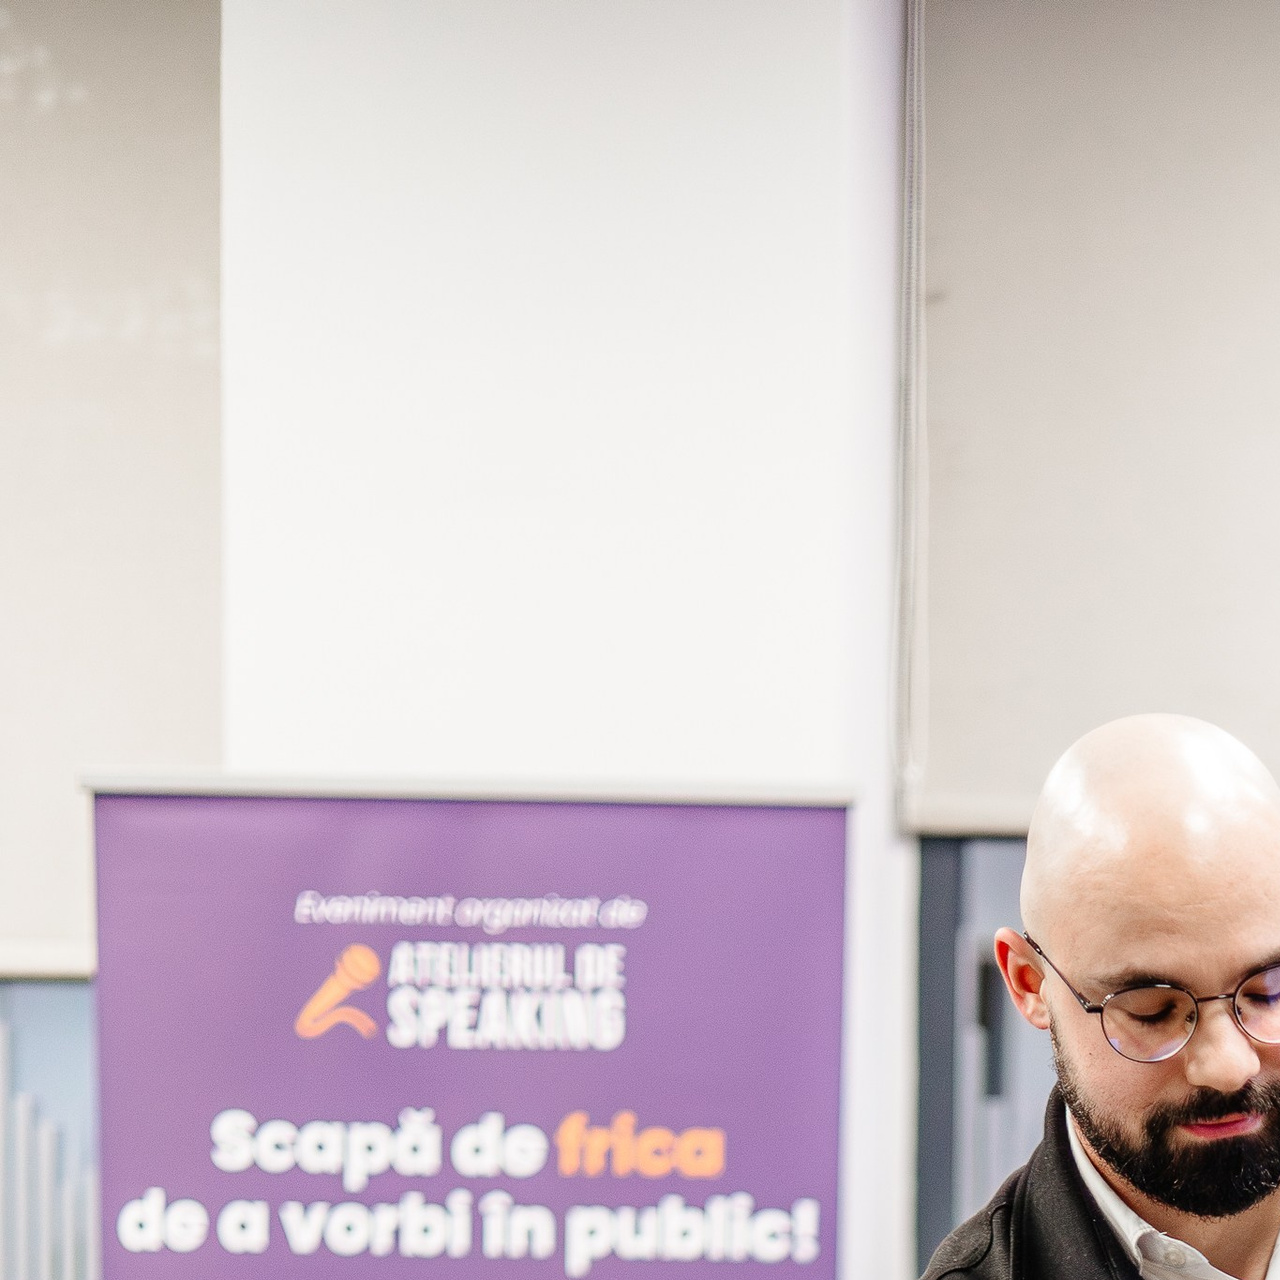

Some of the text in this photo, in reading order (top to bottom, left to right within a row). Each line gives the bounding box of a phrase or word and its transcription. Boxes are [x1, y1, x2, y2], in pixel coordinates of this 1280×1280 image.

[295, 890, 455, 926] Eveniment
[599, 894, 648, 929] de
[388, 941, 627, 990] ATELIERUL DE
[387, 984, 627, 1050] SPEAKING
[210, 1106, 727, 1193] Scapă de frica
[116, 1186, 821, 1279] de a vorbi în public!
